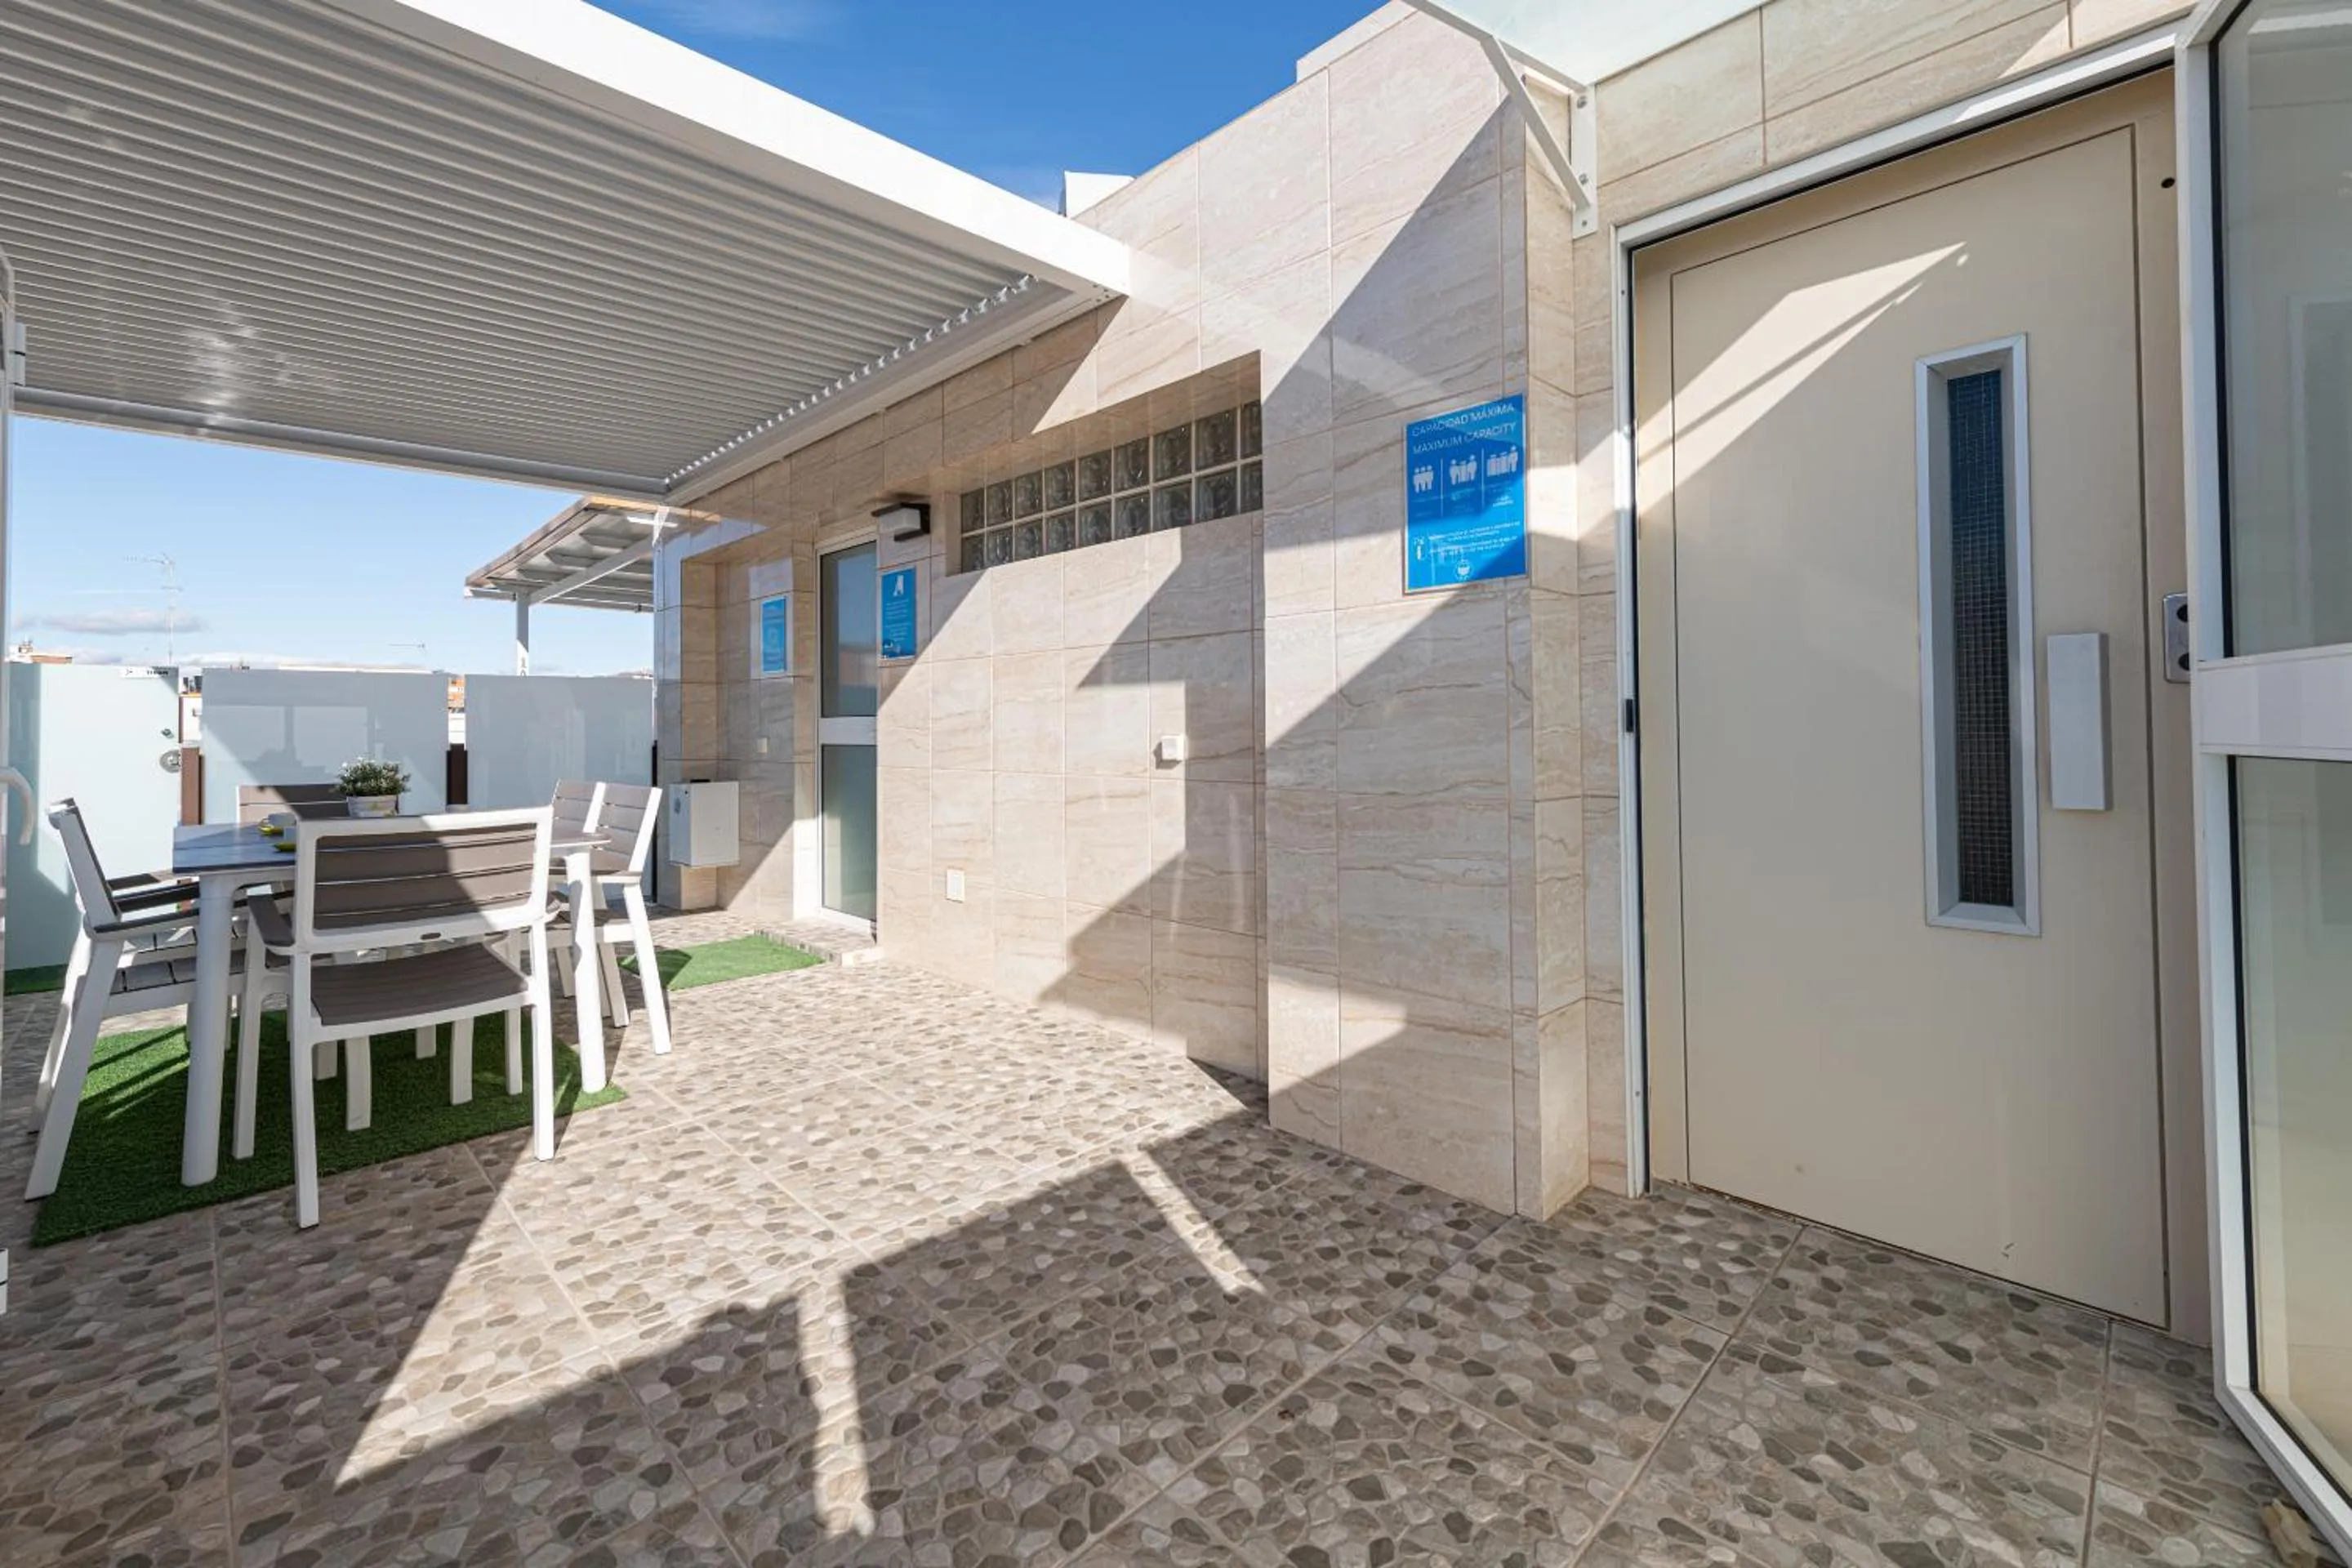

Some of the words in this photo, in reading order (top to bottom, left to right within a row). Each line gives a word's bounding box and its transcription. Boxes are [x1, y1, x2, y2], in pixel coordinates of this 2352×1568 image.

[1411, 414, 1469, 437] CAPACIDAD
[1413, 435, 1462, 455] MAXIMUM
[1463, 421, 1517, 442] CAPACITY
